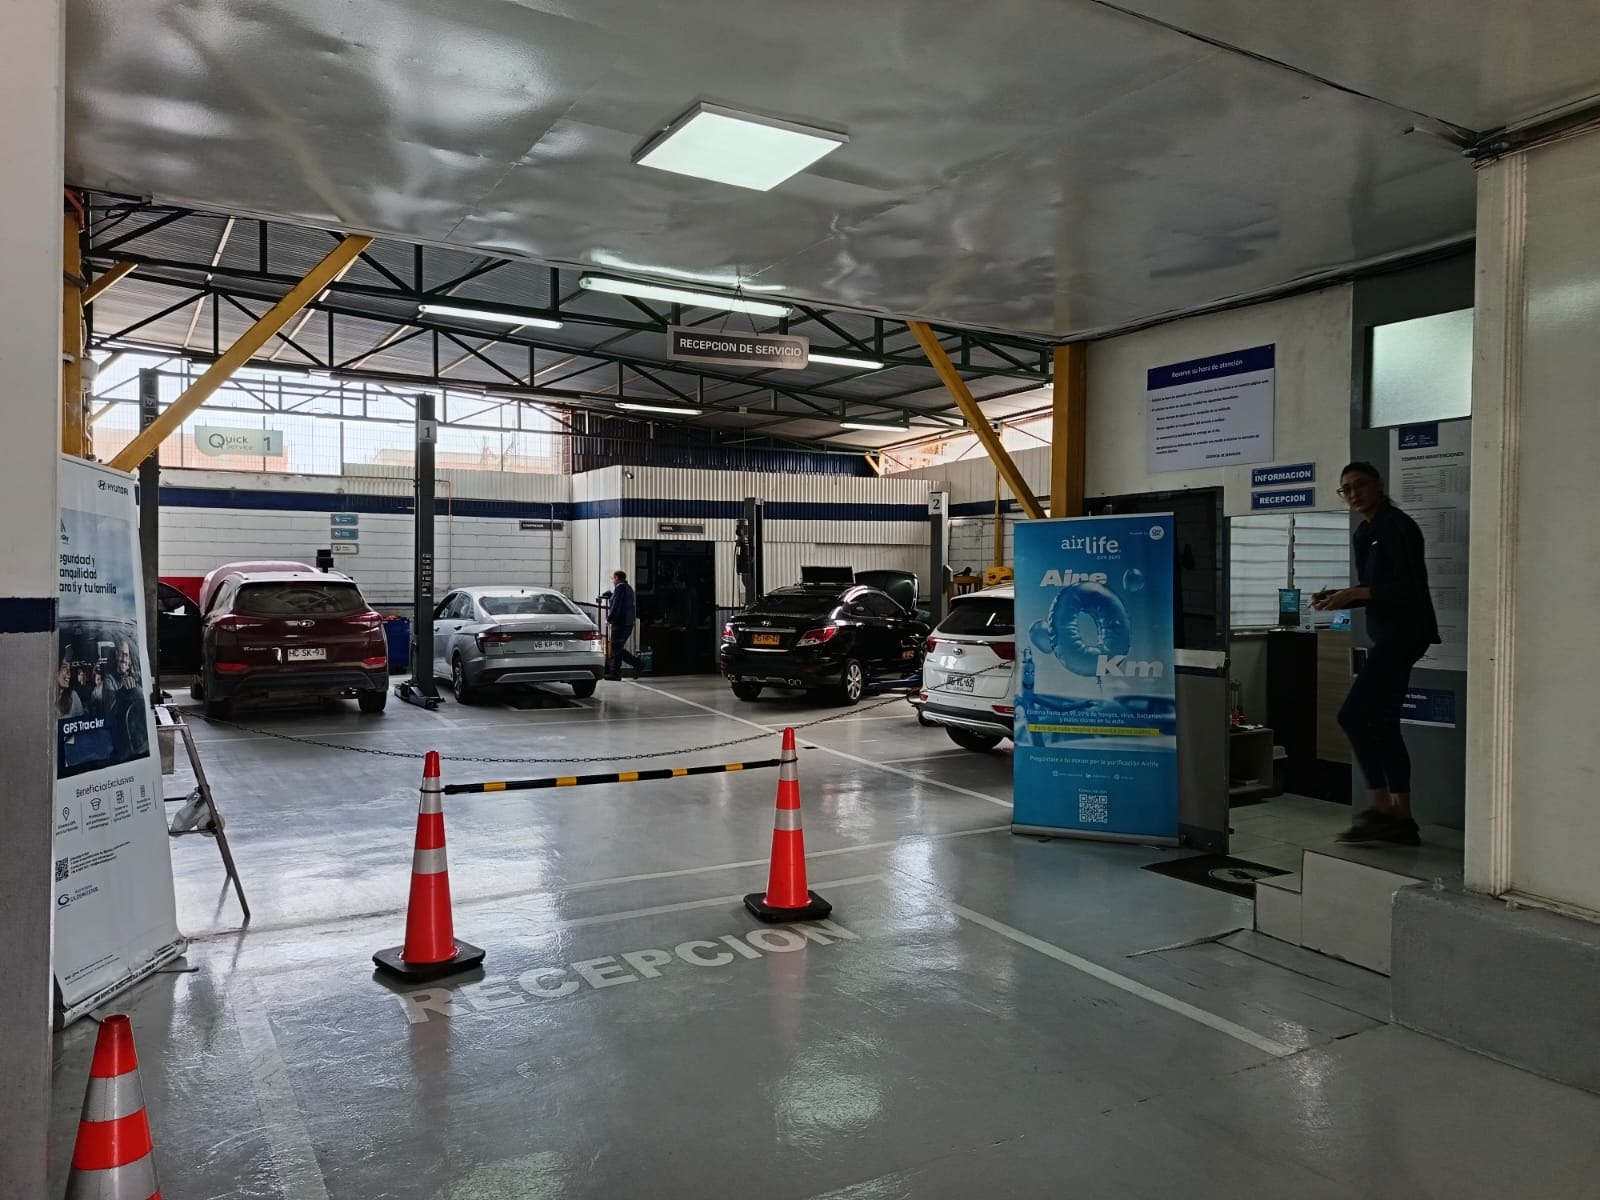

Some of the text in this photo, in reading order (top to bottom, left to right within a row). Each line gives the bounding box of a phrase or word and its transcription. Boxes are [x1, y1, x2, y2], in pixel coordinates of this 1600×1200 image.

[680, 338, 801, 357] RECEPCION DE SERVICIO
[1171, 369, 1191, 378] Reserve
[1198, 365, 1210, 373] hora
[1211, 363, 1219, 371] de
[425, 426, 432, 438] 1
[208, 433, 271, 451] Quick 1
[1254, 470, 1311, 482] INFORMACION
[932, 499, 940, 510] 2
[1259, 494, 1306, 504] RECEPCION
[1061, 535, 1120, 554] airlife
[59, 553, 91, 566] eguridad
[59, 567, 97, 580] anquilidad
[1040, 569, 1108, 587] Aire
[59, 582, 72, 592] ara
[77, 584, 82, 595] y
[84, 582, 93, 593] tu
[1095, 654, 1164, 678] Km
[63, 717, 105, 734] GPS Tracker
[76, 775, 135, 798] Beneficios Exclusivos
[399, 918, 861, 1025] RECEPCION
